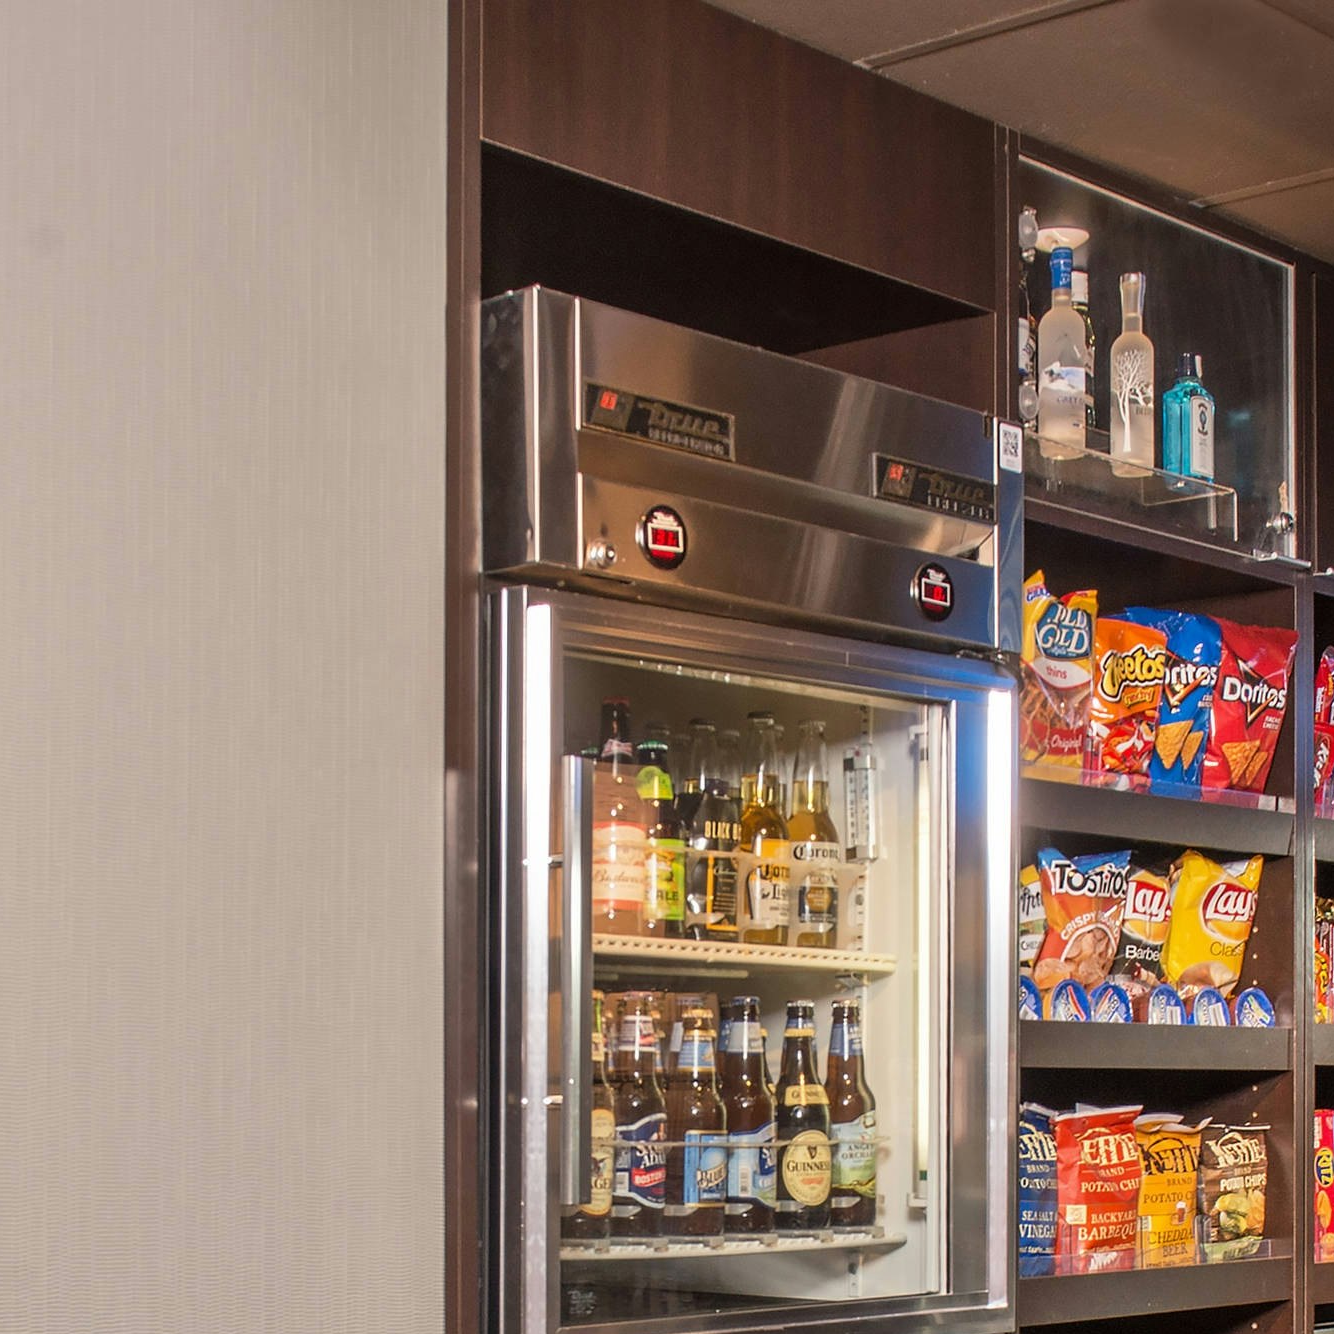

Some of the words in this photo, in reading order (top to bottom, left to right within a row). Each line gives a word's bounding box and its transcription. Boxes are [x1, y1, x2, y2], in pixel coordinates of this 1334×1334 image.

[1222, 676, 1287, 710] Doritos
[1060, 913, 1097, 941] CRISPY
[1205, 1134, 1266, 1168] KETTLE
[1245, 1172, 1267, 1188] CHIPS
[1317, 1150, 1333, 1186] RITZ
[1143, 1191, 1181, 1204] POTATO
[1163, 1243, 1188, 1258] BEER
